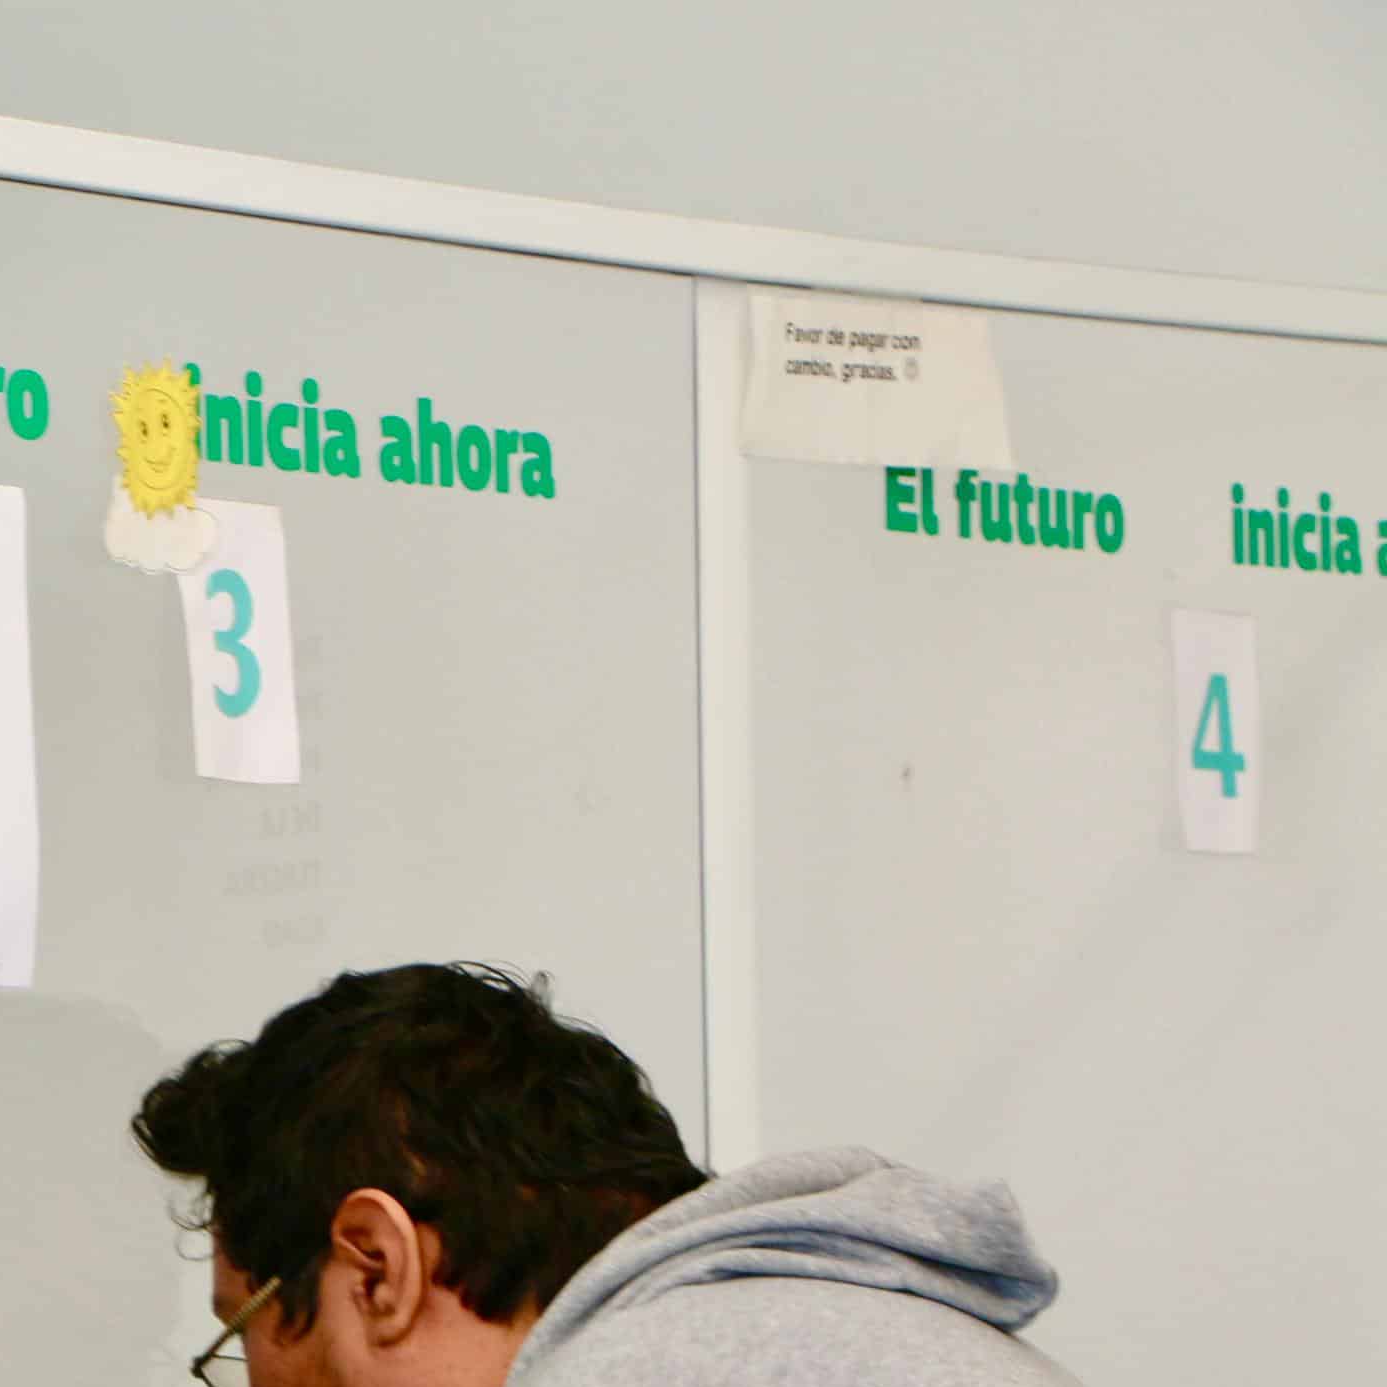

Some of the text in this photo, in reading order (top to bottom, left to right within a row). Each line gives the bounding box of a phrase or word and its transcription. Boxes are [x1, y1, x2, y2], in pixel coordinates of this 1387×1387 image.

[785, 357, 897, 384] cambio, gracias.
[786, 321, 922, 353] Favor de pagar con
[379, 396, 556, 500] ahora
[885, 466, 939, 536] El
[954, 468, 1125, 554] futuro
[1232, 482, 1363, 575] inicia
[204, 569, 261, 717] 3
[1192, 673, 1246, 798] 4
